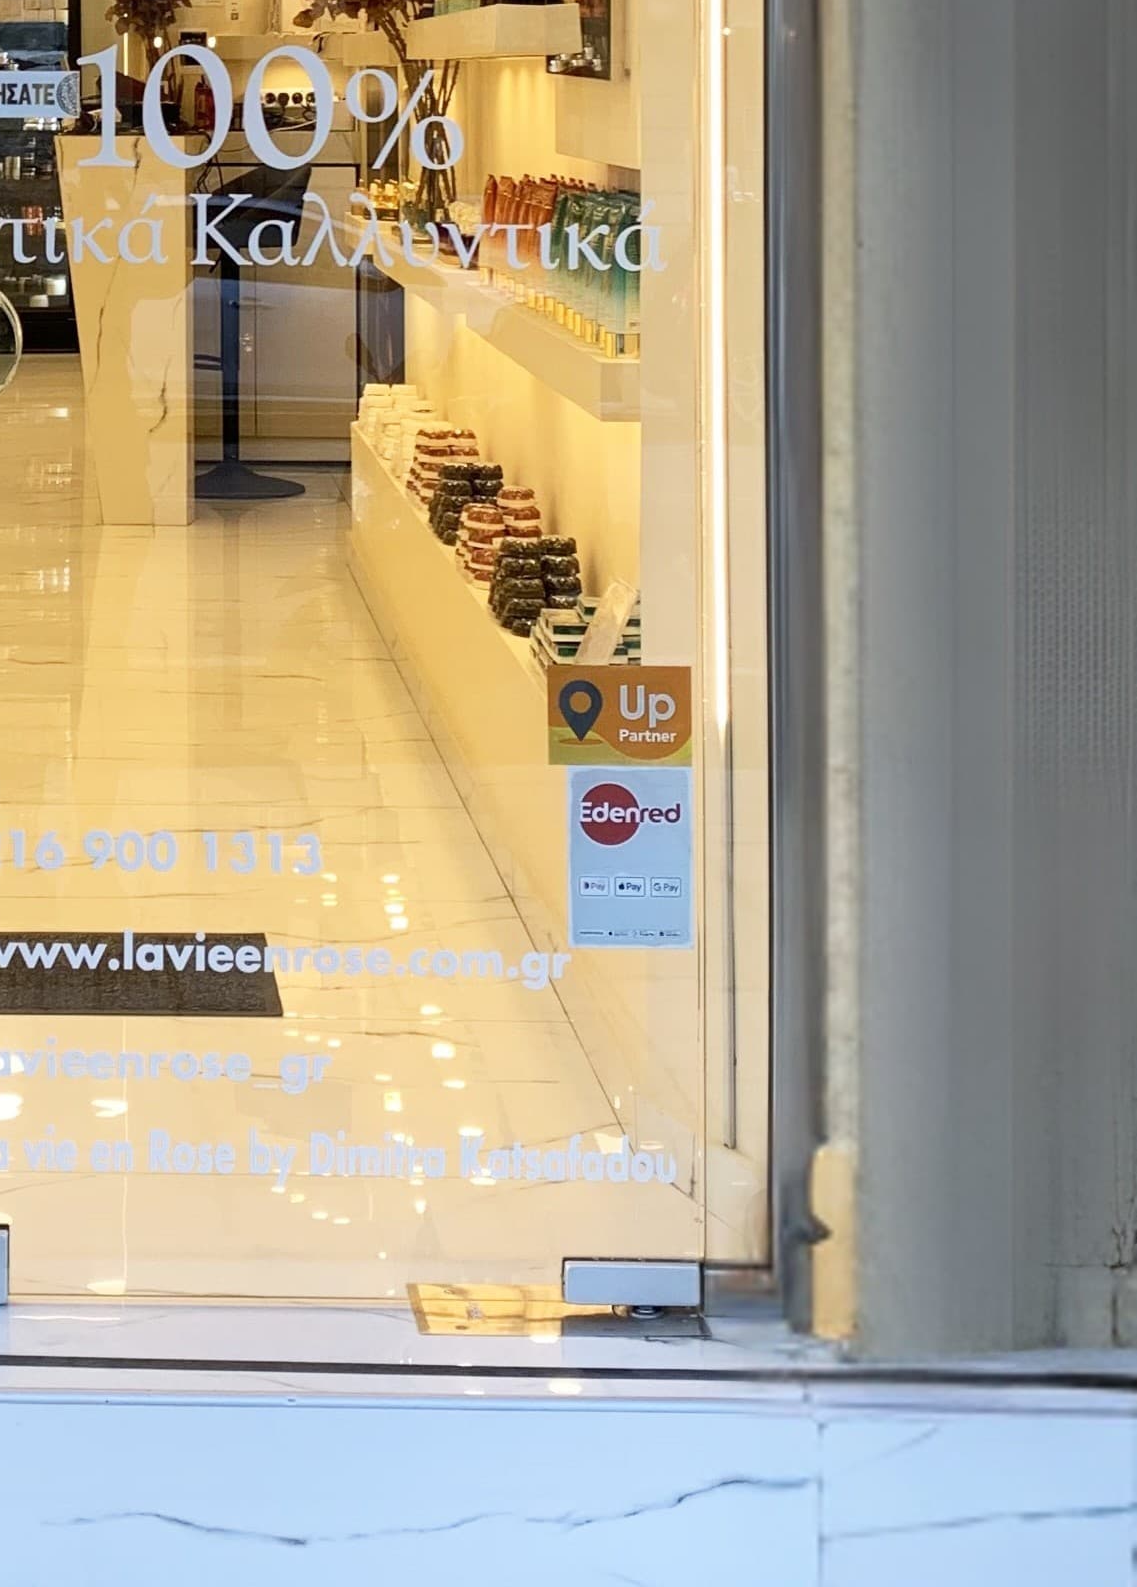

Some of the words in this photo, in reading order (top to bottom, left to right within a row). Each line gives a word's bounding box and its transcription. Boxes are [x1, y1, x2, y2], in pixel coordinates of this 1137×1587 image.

[76, 43, 465, 172] 100%
[188, 191, 668, 273] Καλλυντικά
[619, 684, 676, 728] Up
[619, 729, 677, 743] Partner
[579, 801, 681, 824] Edenred
[83, 829, 178, 872] 900
[202, 832, 323, 876] 1313
[626, 882, 642, 892] Pay
[23, 1124, 78, 1171] vie
[90, 1137, 134, 1172] en
[148, 1128, 235, 1174] Rose
[248, 1126, 298, 1187] by
[308, 1130, 446, 1180] Dimitra
[459, 1134, 678, 1185] Katsafadou
